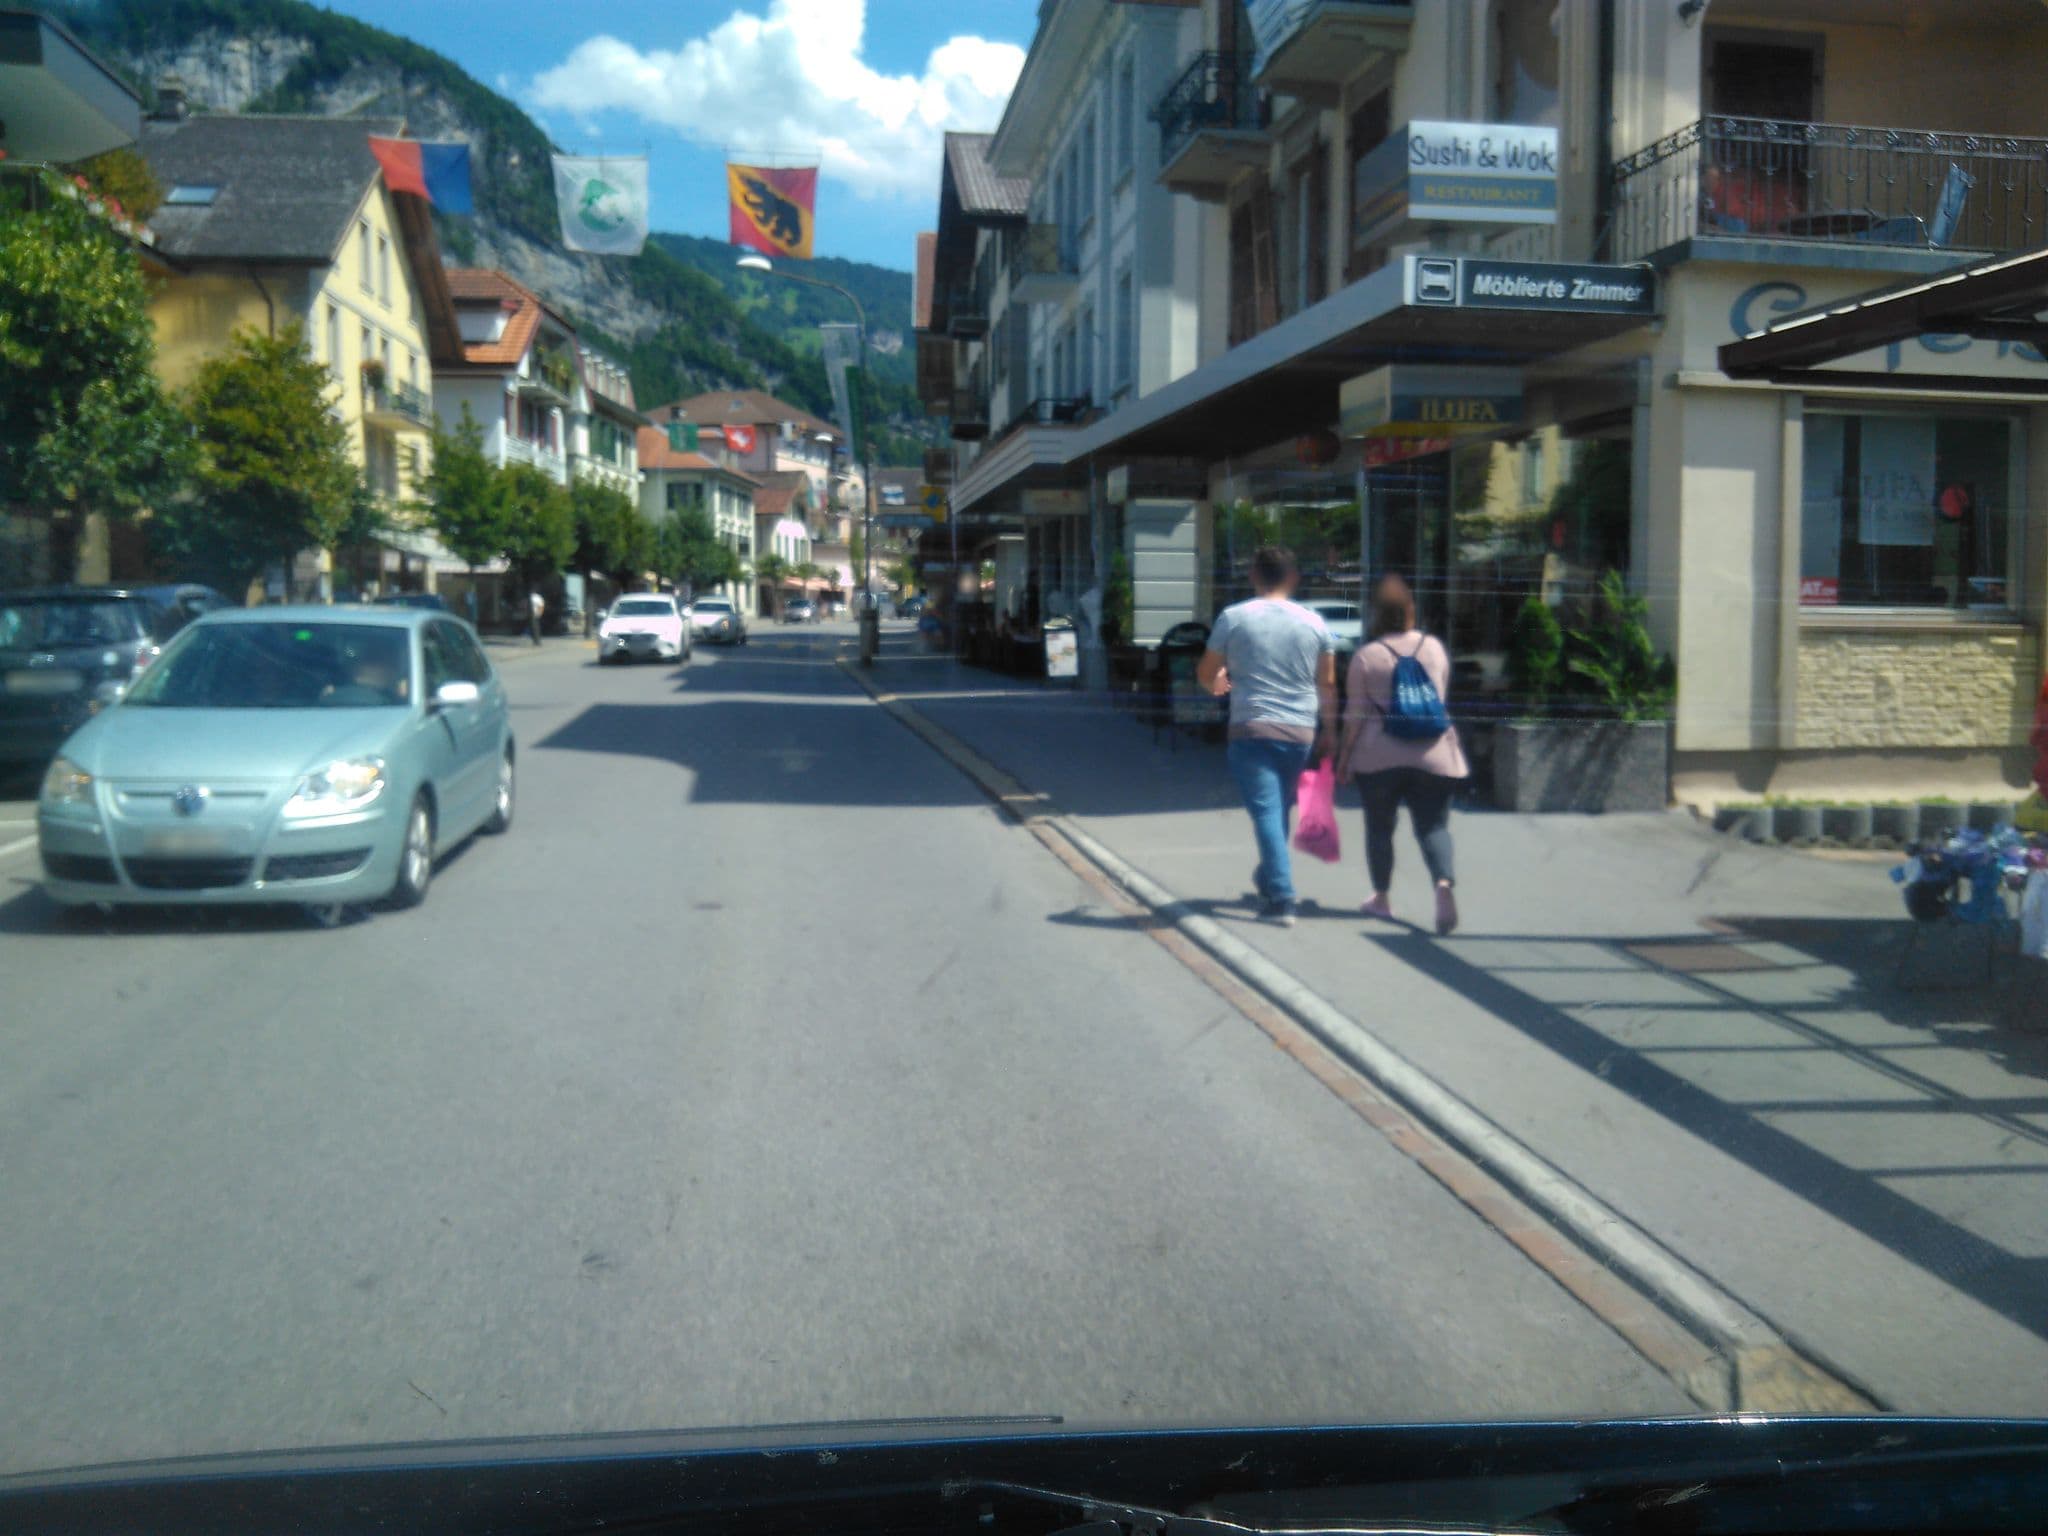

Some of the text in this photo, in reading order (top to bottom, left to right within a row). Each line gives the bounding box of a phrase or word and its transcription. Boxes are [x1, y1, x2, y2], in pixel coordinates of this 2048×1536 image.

[1410, 135, 1556, 172] Sushi & Wok
[1424, 184, 1541, 200] RESTAURANT
[1472, 273, 1643, 301] Möblierte Zimmer
